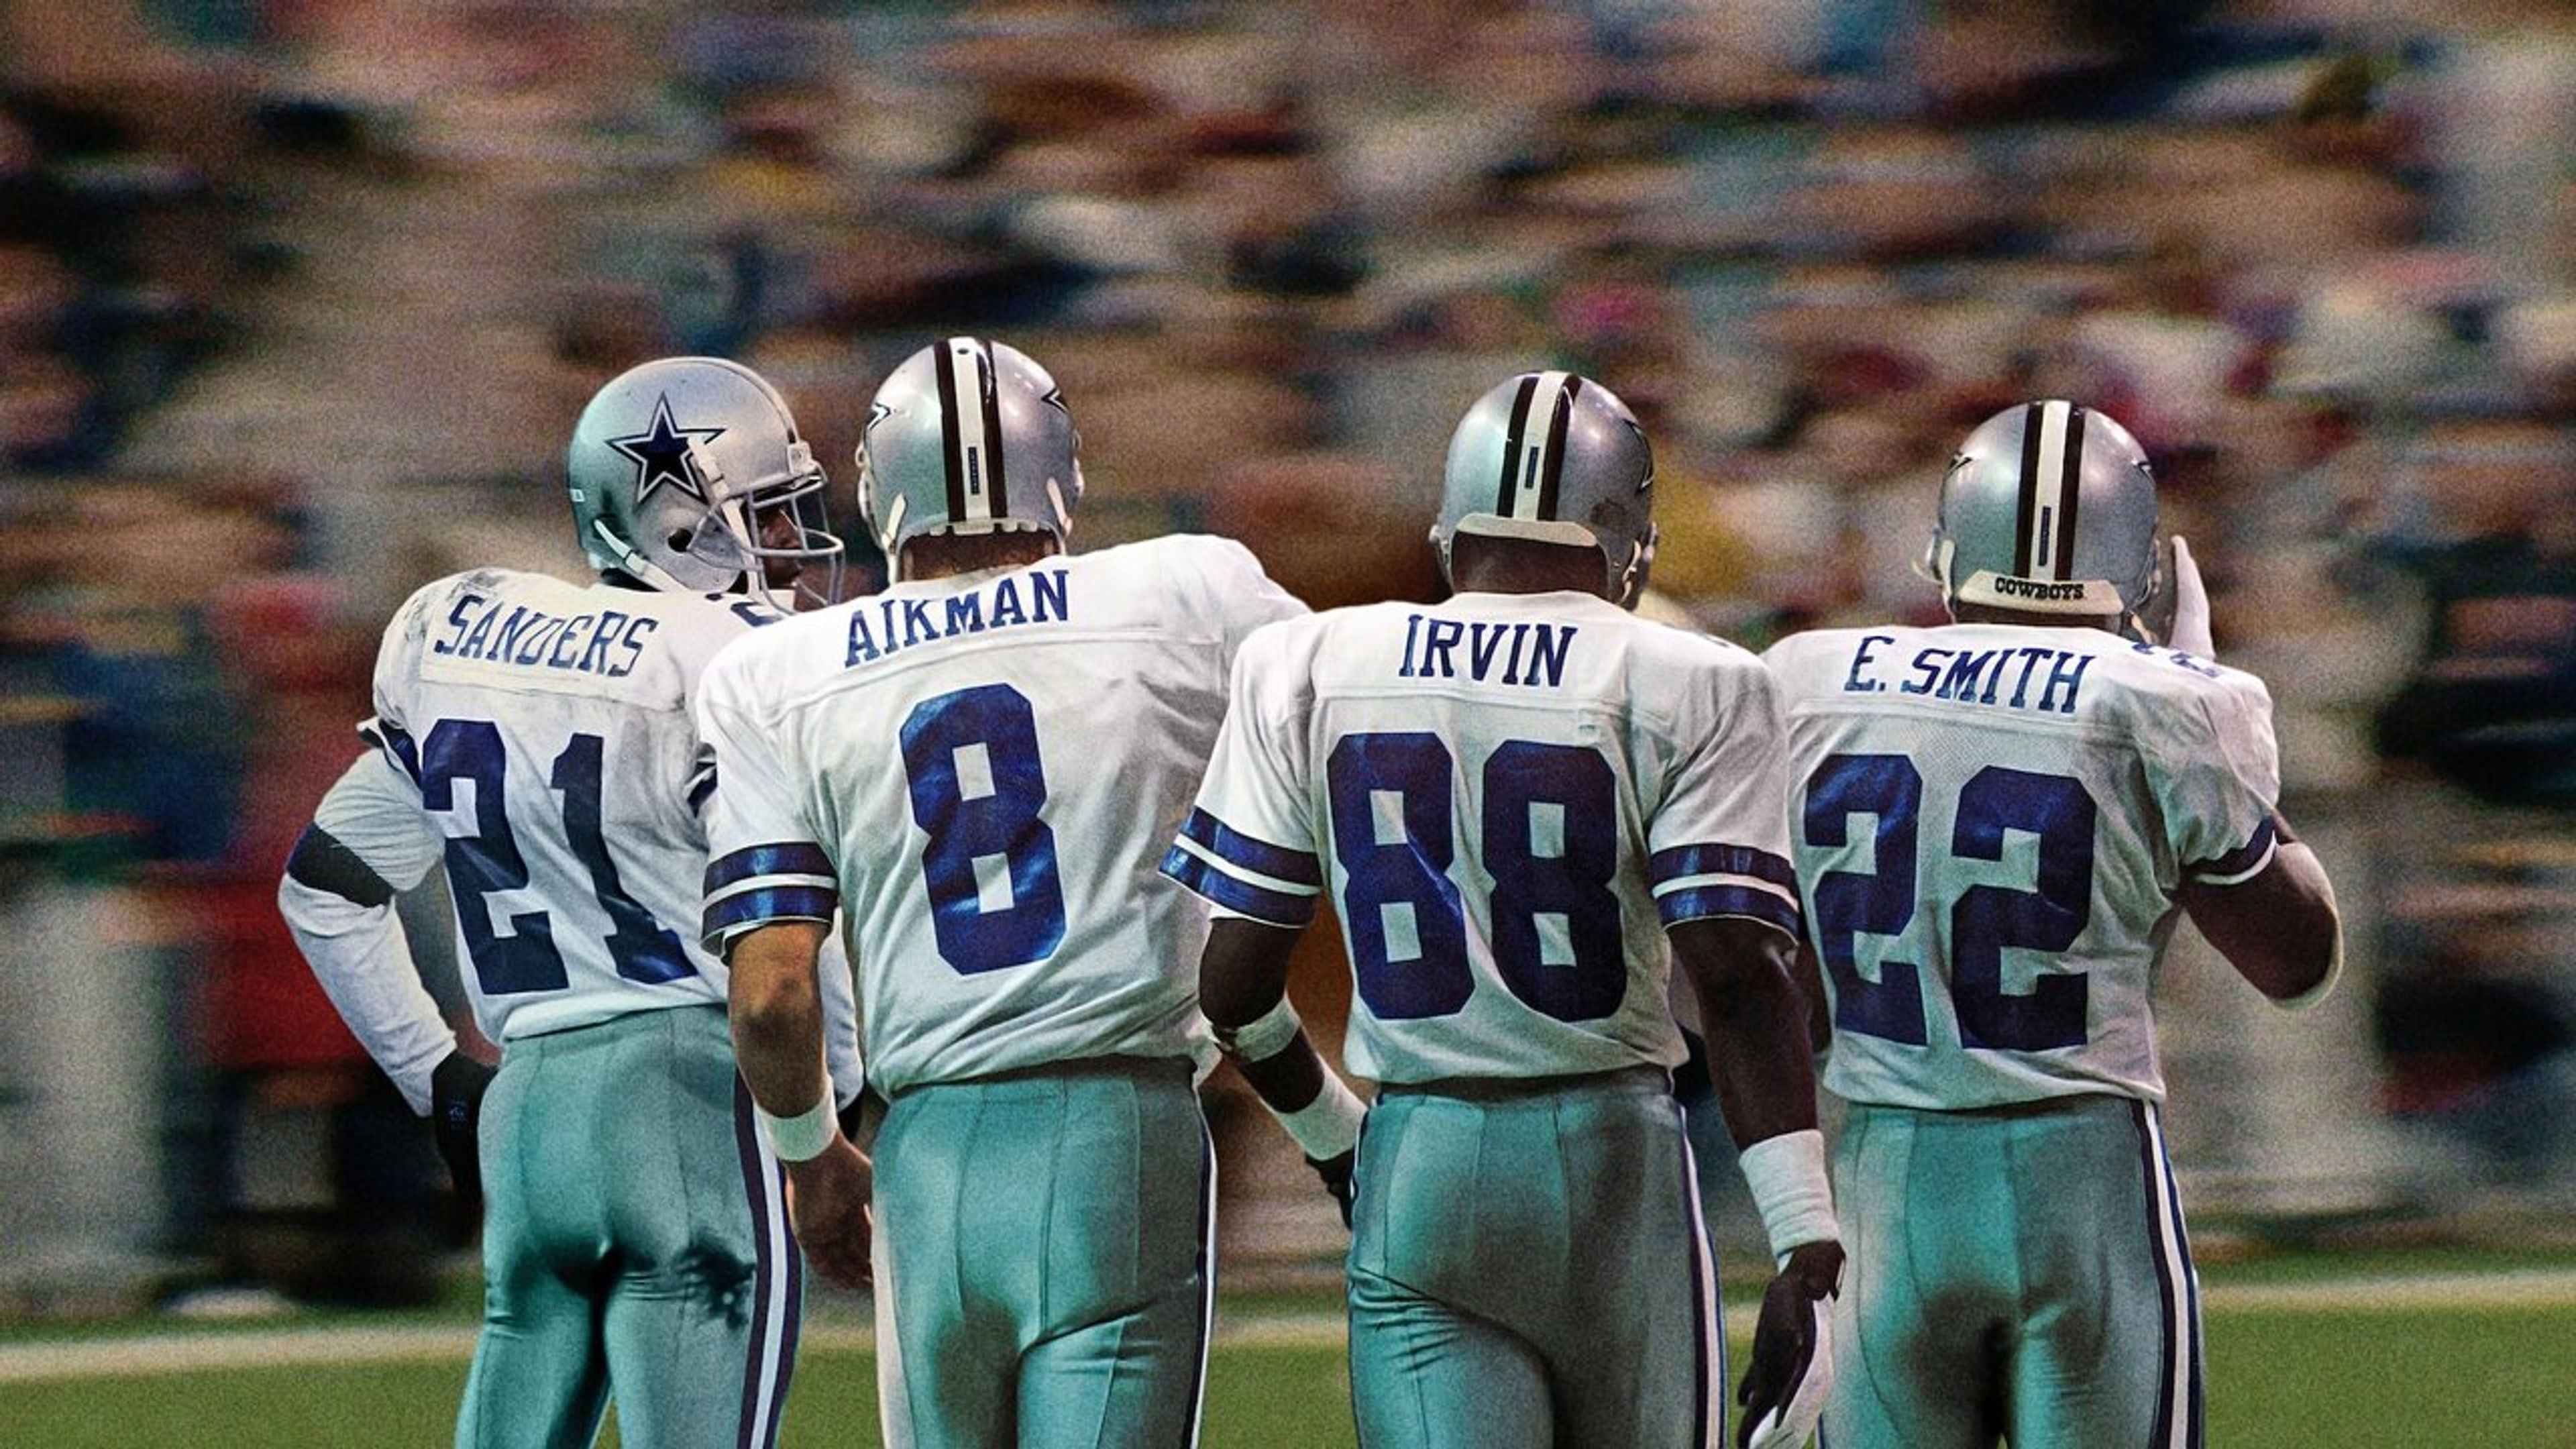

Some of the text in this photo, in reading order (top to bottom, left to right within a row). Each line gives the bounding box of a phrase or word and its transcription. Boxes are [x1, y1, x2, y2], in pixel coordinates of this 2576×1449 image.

[435, 594, 659, 678] SANDERS
[845, 570, 1070, 668] AIKMAN
[1994, 577, 2084, 600] COWBOYS
[1399, 614, 1578, 688] IRVIN
[1900, 647, 2096, 714] SMITH
[422, 718, 700, 996] 21
[899, 682, 1067, 976] 8
[1326, 732, 1627, 1023] 88
[1803, 753, 2098, 1051] 22
